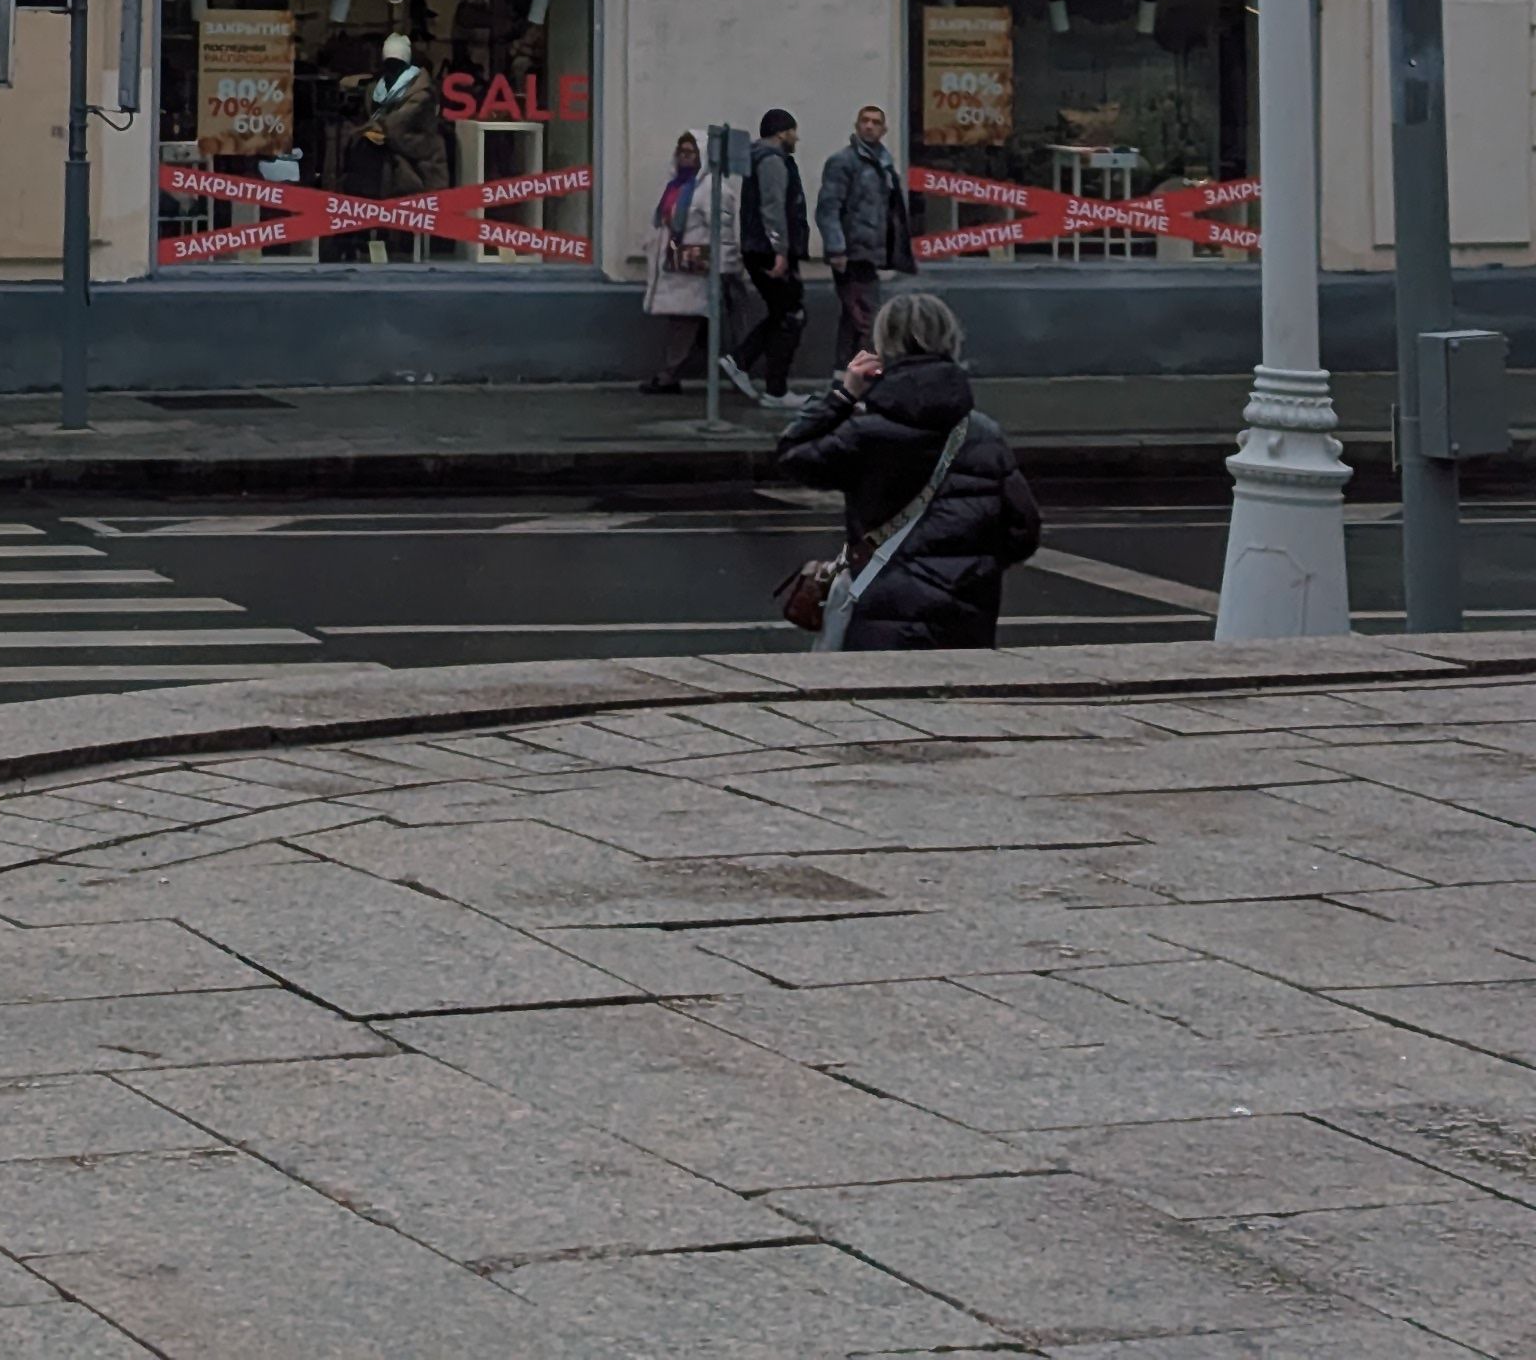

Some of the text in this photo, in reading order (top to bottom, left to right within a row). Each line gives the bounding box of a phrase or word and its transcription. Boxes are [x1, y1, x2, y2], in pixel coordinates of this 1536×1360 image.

[208, 96, 262, 117] 70%
[218, 77, 285, 103] 80%
[441, 71, 589, 122] SALE
[233, 114, 285, 134] 60%
[171, 170, 284, 205] ЗАКРЫТИЕ
[481, 170, 590, 204] ЗАКРЫТИЕ
[924, 173, 1029, 207] ЗАКРЫТИЕ
[325, 196, 437, 231] ЗАКРЫТИЕ
[1066, 199, 1170, 232] ЗАКРЫТИЕ
[174, 223, 287, 258] ЗАКРЫТИЕ
[478, 224, 587, 259] ЗАКРЫТИЕ
[920, 223, 1025, 256] ЗАКРЫТИЕ
